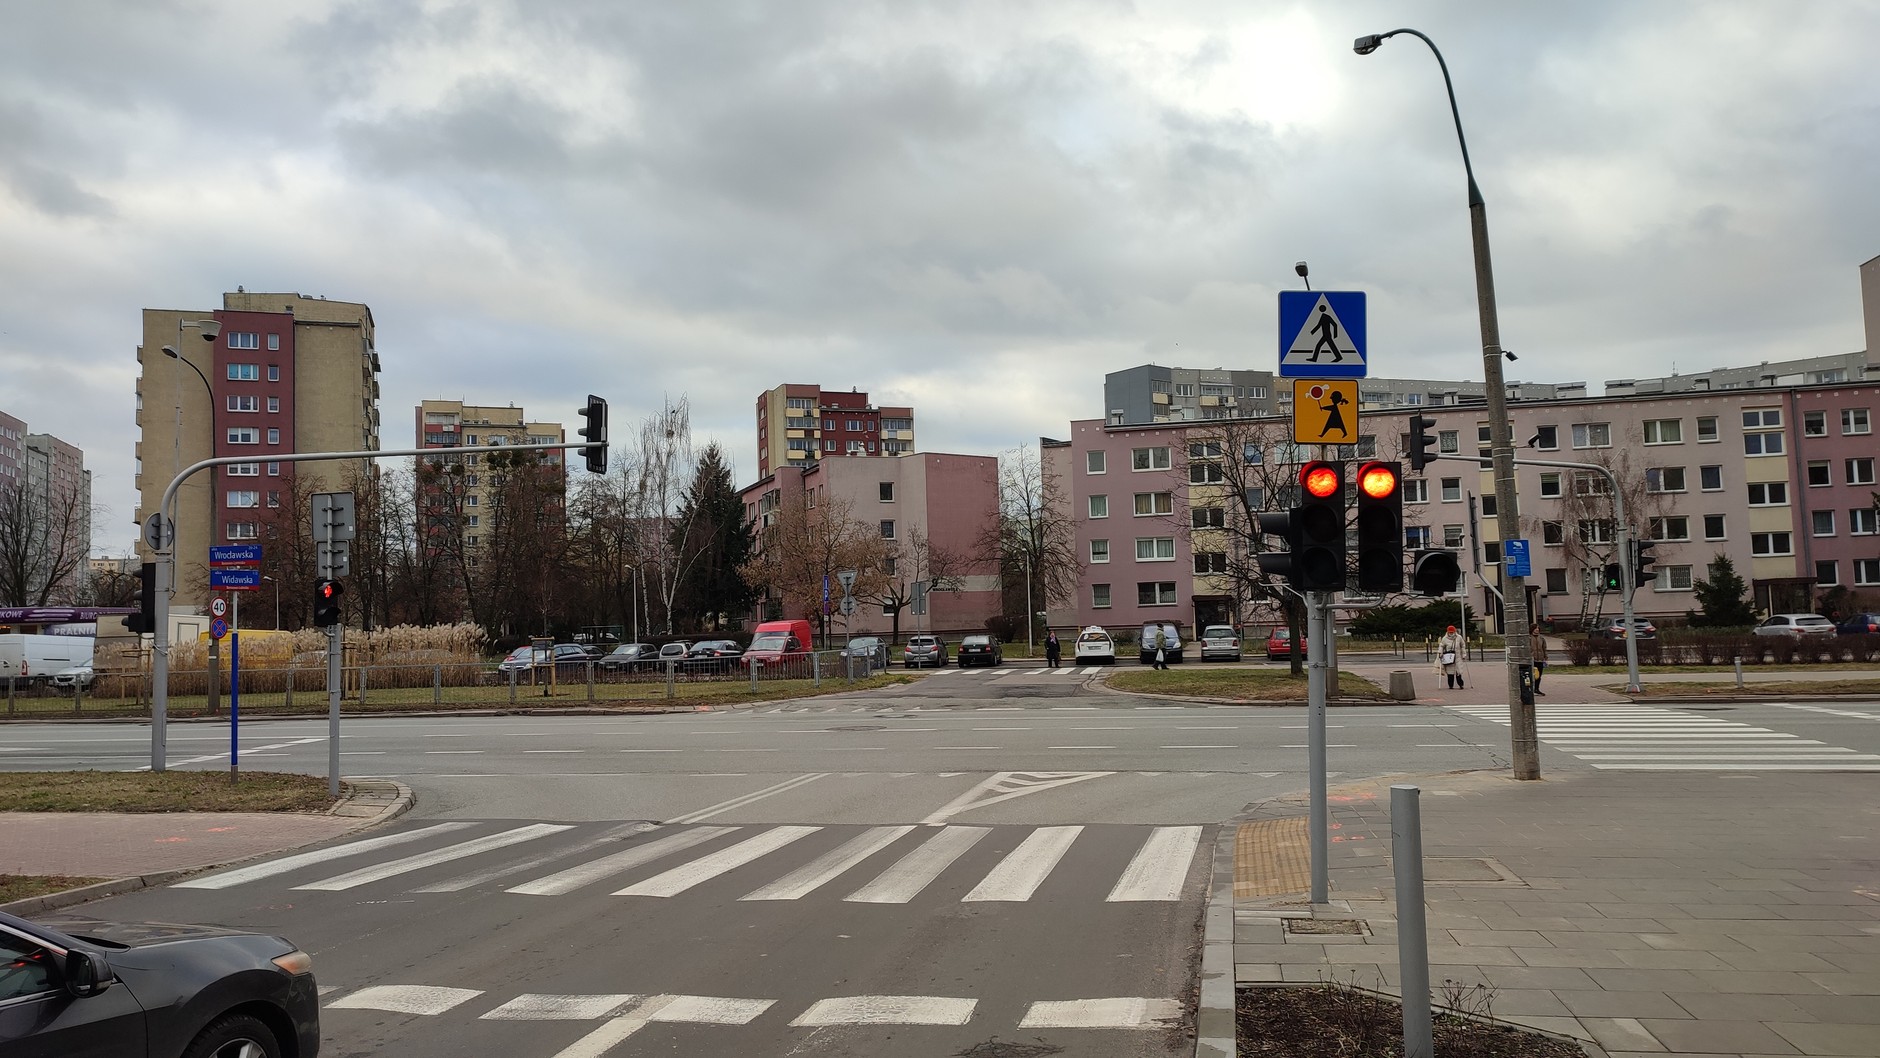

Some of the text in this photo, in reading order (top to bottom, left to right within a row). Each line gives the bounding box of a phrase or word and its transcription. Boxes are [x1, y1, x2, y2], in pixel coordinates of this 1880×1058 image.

[221, 575, 253, 584] Widawska
[213, 602, 225, 612] 40
[0, 610, 23, 619] KOWE
[53, 626, 96, 636] PRALNIA
